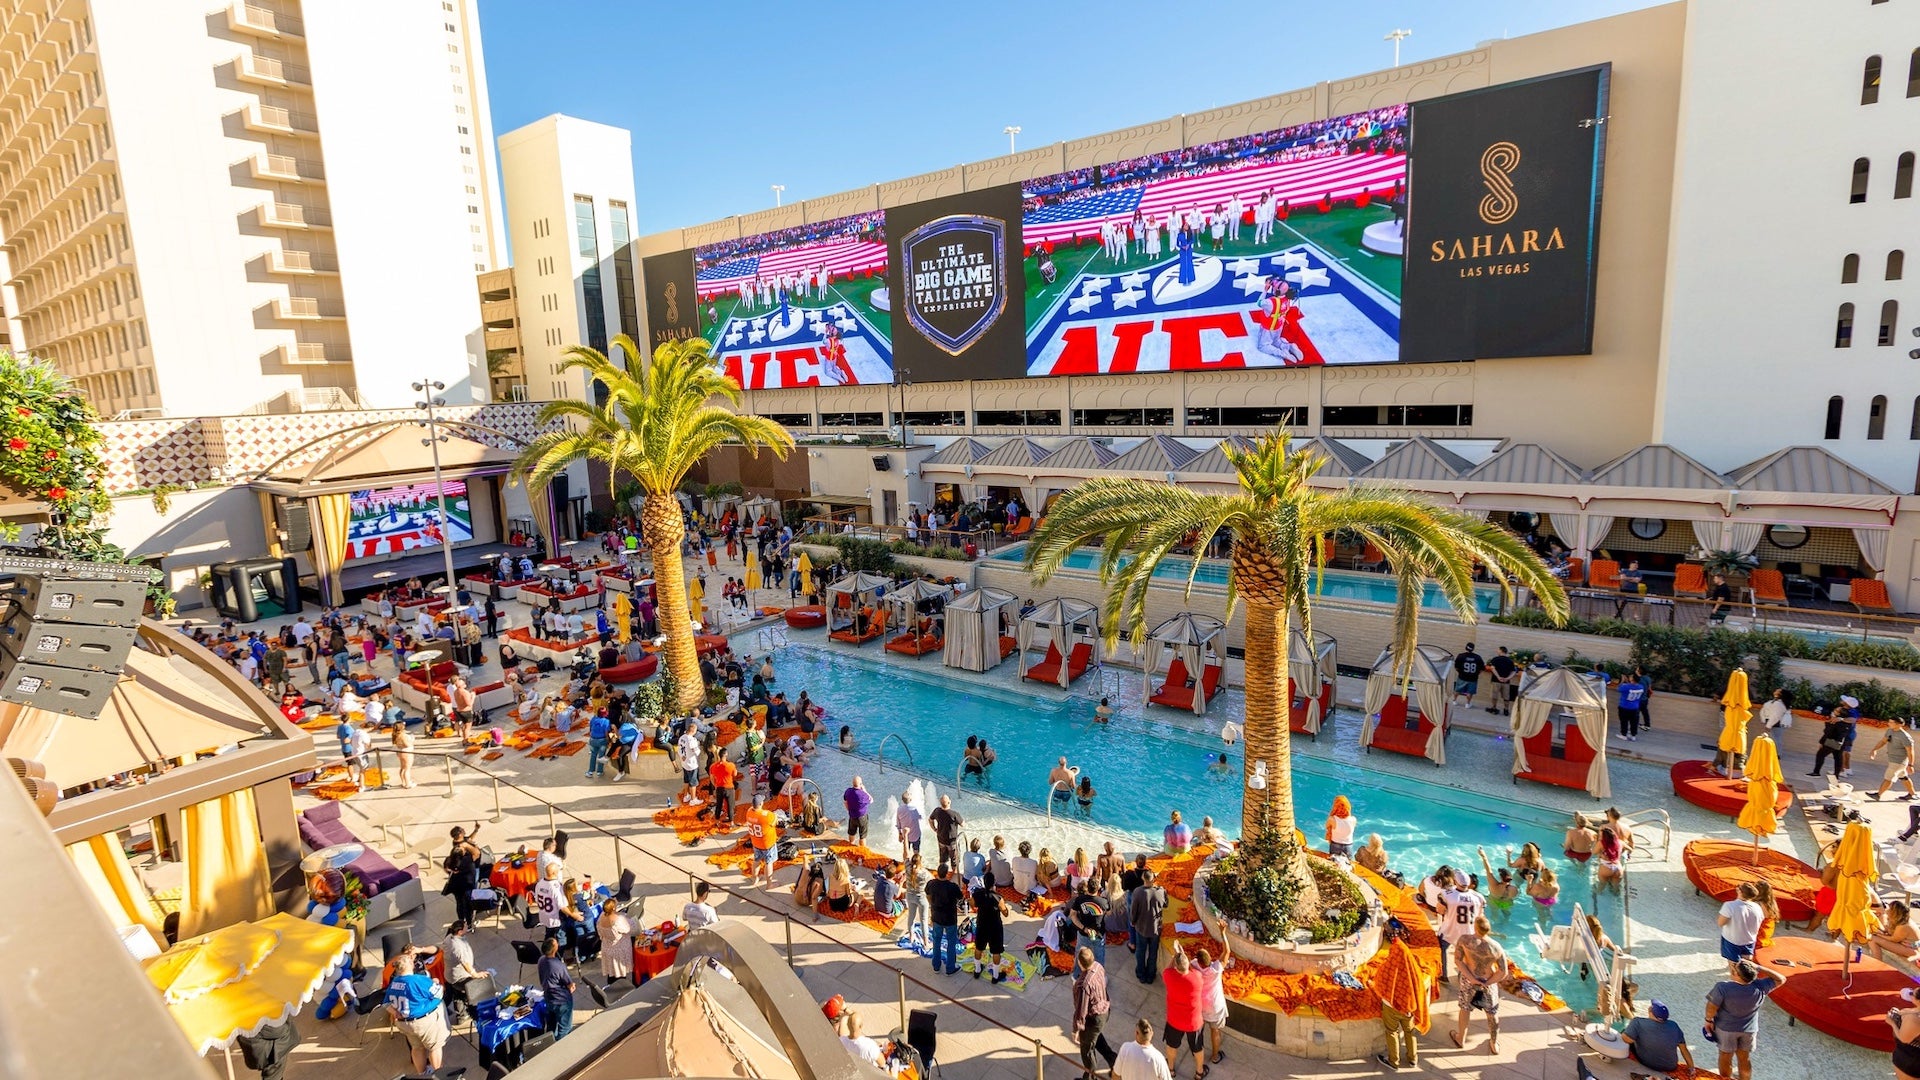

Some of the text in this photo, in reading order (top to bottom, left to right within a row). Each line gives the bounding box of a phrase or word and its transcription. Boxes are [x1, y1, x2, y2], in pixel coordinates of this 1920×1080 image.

[939, 244, 964, 257] THE
[1430, 227, 1565, 262] SAHARA
[920, 252, 985, 271] ULTIMATE
[1460, 262, 1530, 278] LAS VEGAS
[914, 264, 993, 291] BIG GAME
[915, 283, 993, 305] TAILGATE
[923, 300, 985, 313] EXPERIENCE
[656, 326, 694, 342] SAHARA
[1463, 662, 1477, 674] 98
[537, 894, 554, 913] 58
